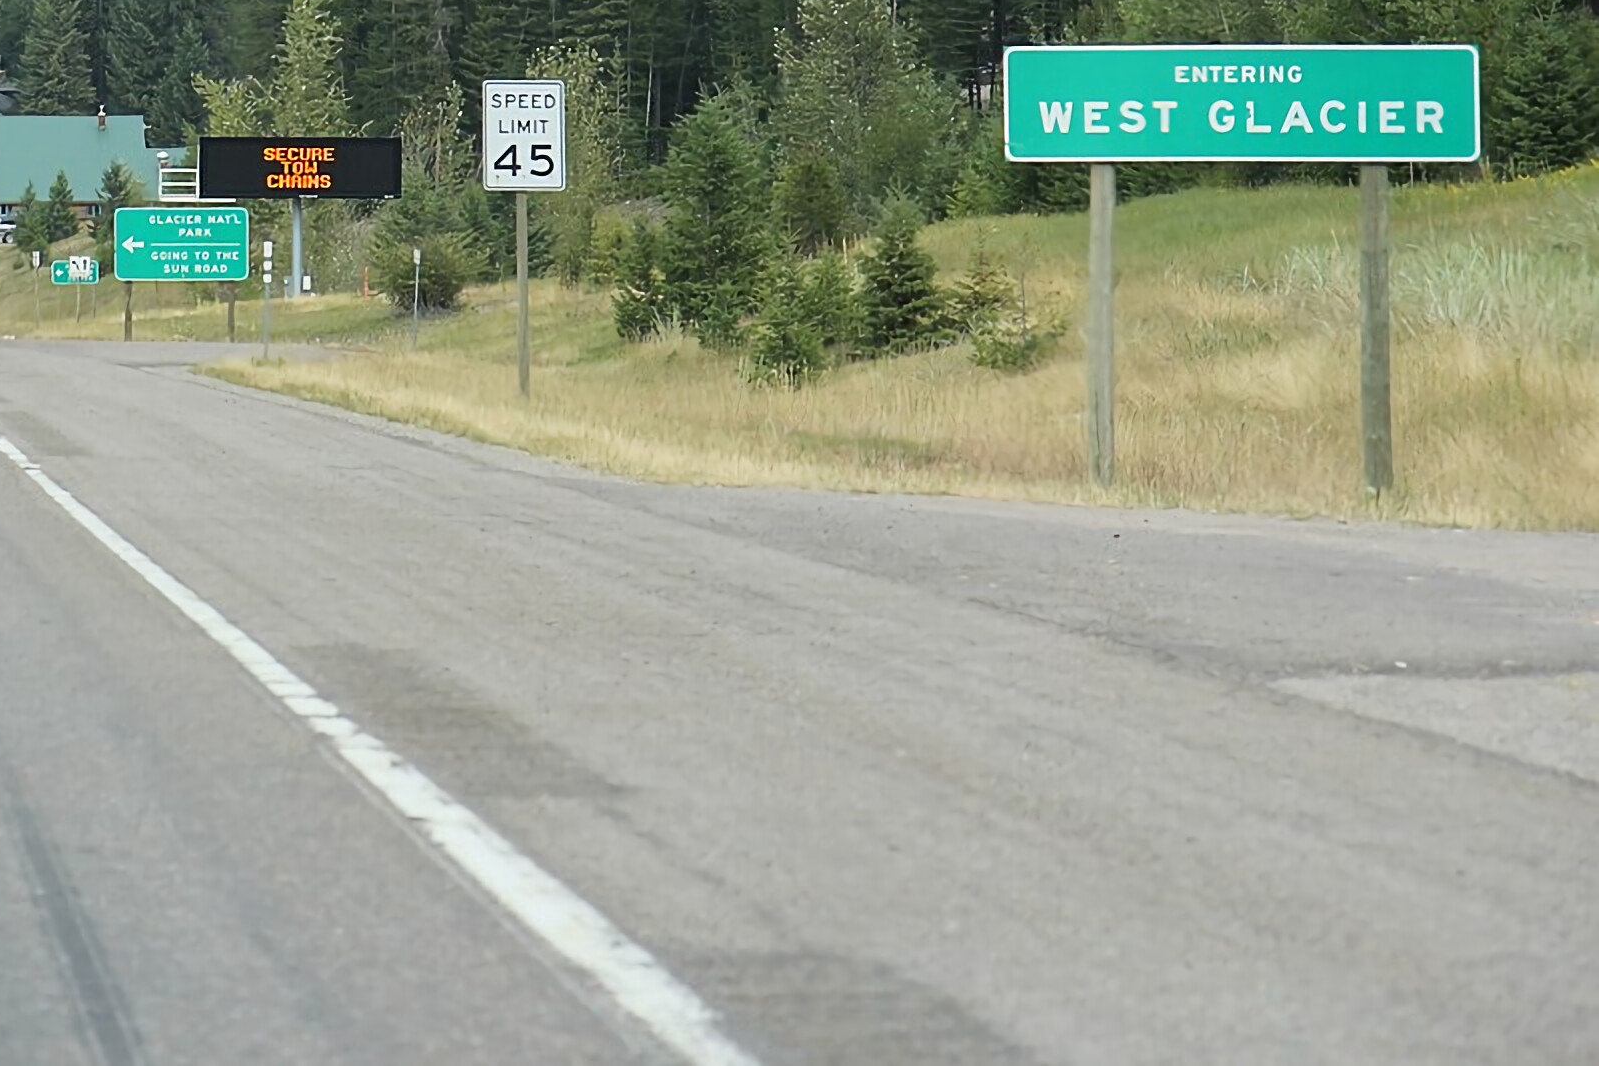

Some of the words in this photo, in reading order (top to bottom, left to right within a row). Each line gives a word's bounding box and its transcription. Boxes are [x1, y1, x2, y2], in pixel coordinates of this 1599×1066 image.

[1174, 65, 1302, 84] ENTERING
[491, 93, 556, 109] SPEED
[1038, 100, 1178, 134] WEST
[1208, 99, 1444, 134] GLACIER
[499, 119, 549, 134] LIMIT
[263, 147, 335, 161] SECURE
[493, 144, 554, 177] 45
[280, 161, 318, 174] TOW
[266, 174, 332, 189] CHAINS
[148, 215, 202, 225] GLACIER
[178, 228, 212, 237] PARK
[150, 251, 188, 261] GOING
[194, 251, 210, 261] TO
[216, 251, 239, 261] THE
[163, 264, 189, 274] SUN
[194, 264, 228, 274] ROAD
